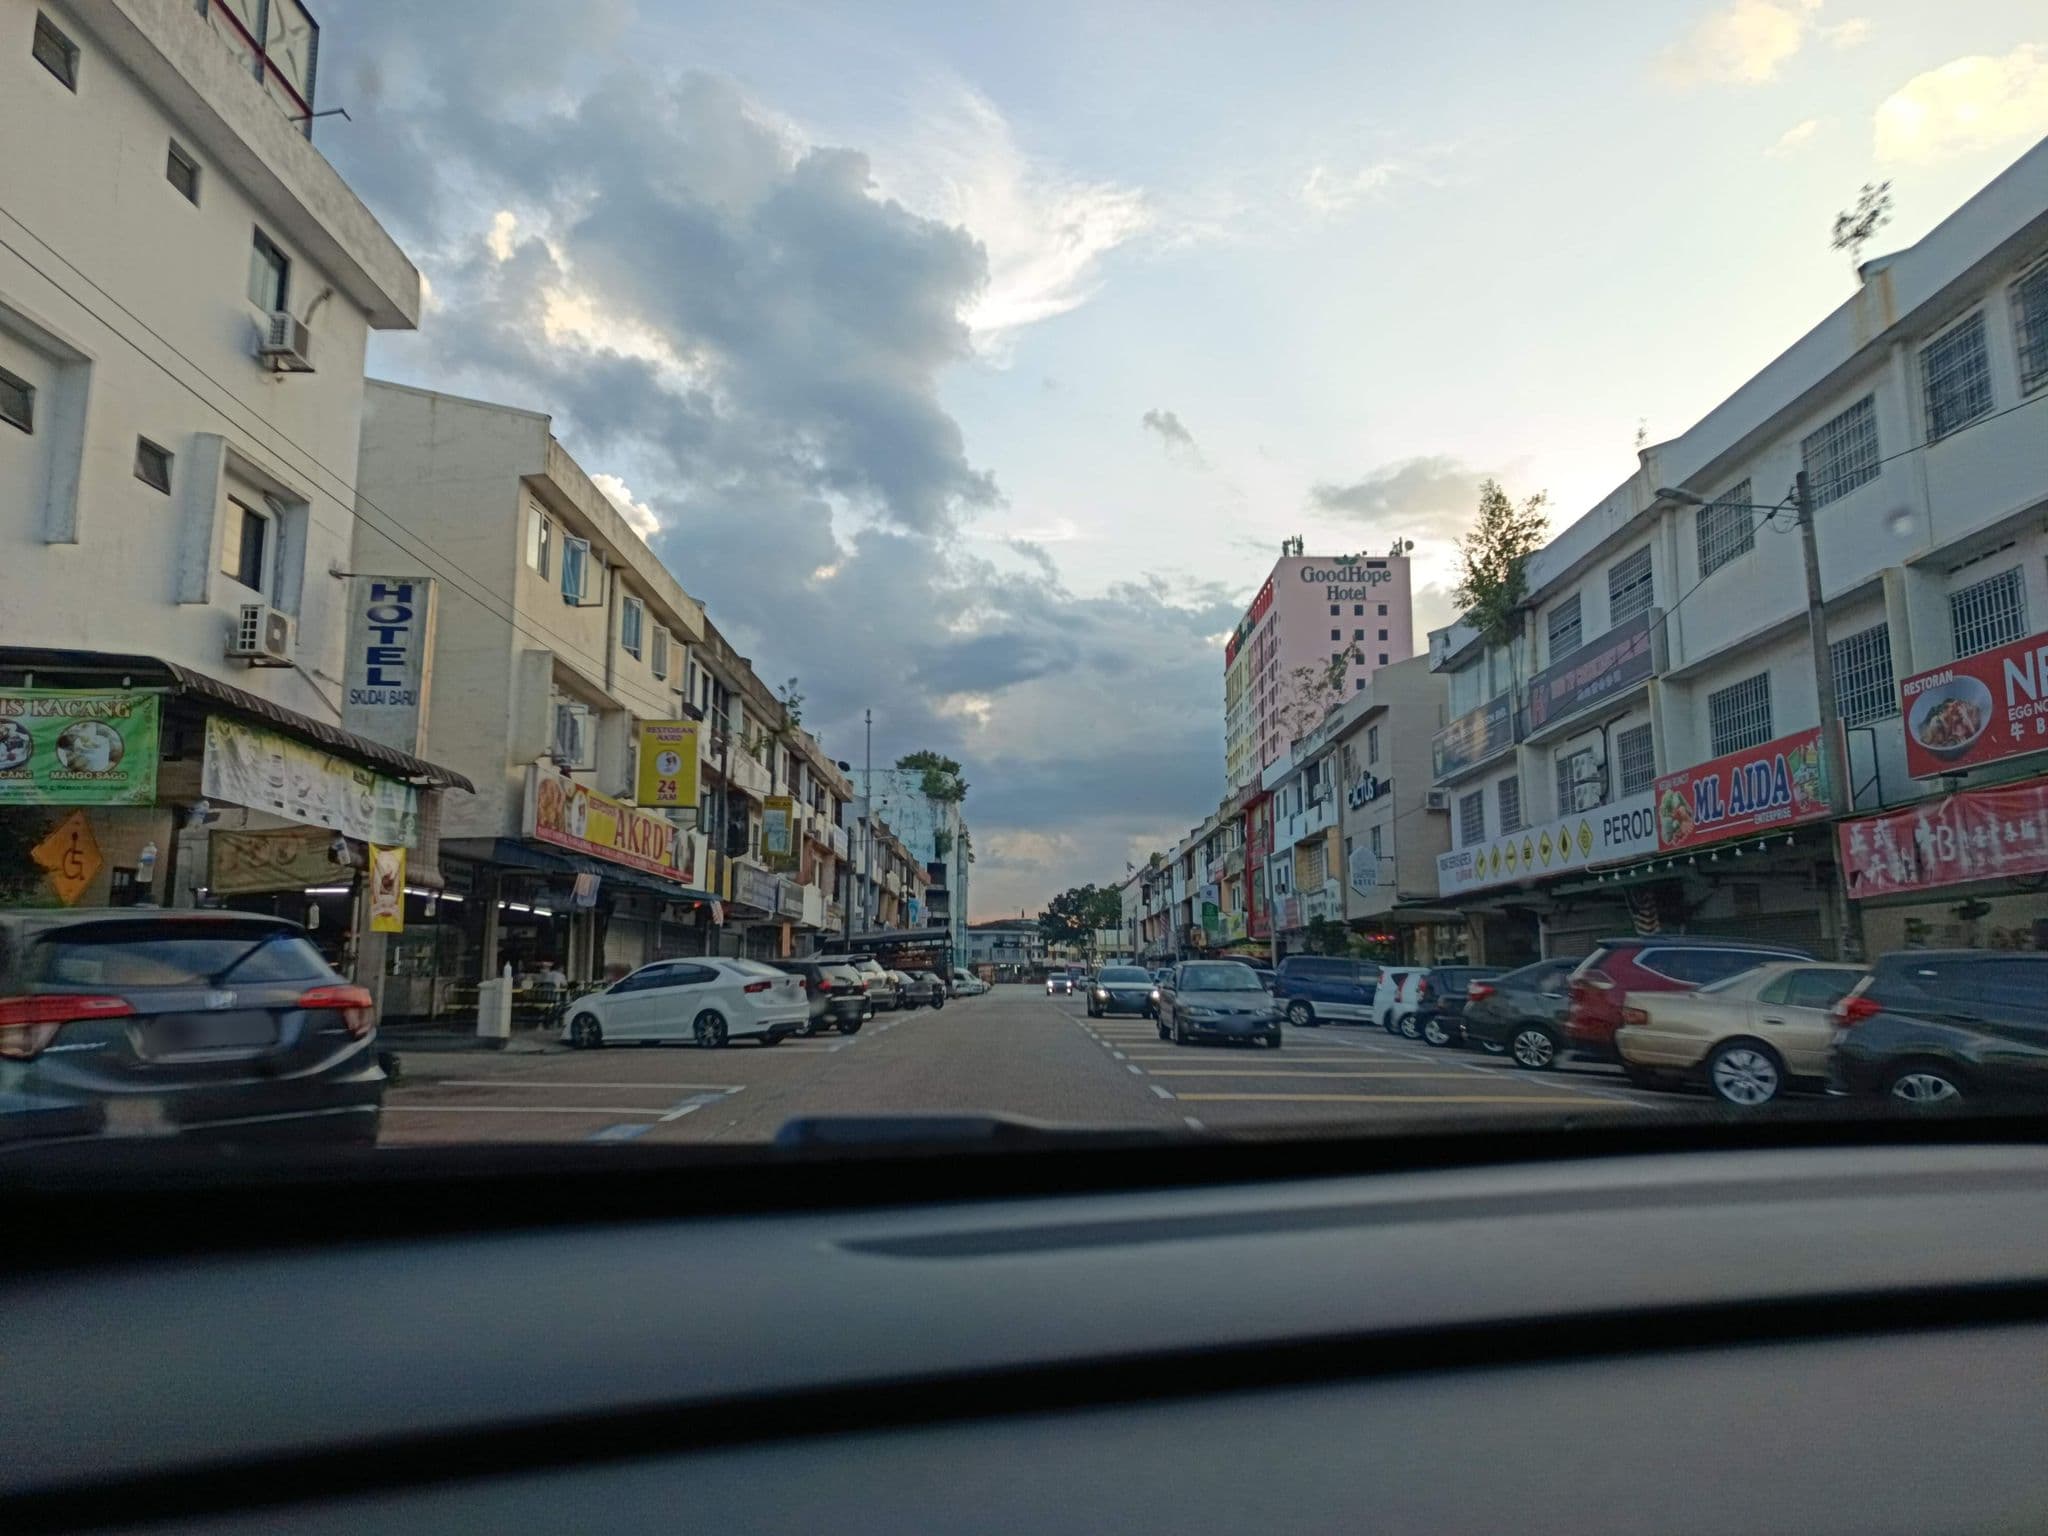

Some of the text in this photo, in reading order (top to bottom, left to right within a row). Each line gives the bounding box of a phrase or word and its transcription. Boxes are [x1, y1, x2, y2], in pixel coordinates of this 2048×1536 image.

[1300, 566, 1392, 587] GoodHope
[1327, 585, 1367, 600] Hotel
[366, 583, 413, 687] HOTEL
[1903, 670, 1953, 697] RESTORAN
[349, 688, 418, 706] SKUDAI BARU
[31, 698, 131, 718] KACANG
[2008, 703, 2033, 721] EGG
[50, 771, 128, 781] MANGO SAGO
[657, 780, 677, 793] 24
[1693, 753, 1792, 825] ML AIDA
[614, 807, 663, 860] AKRD
[1603, 805, 1657, 847] PEROD
